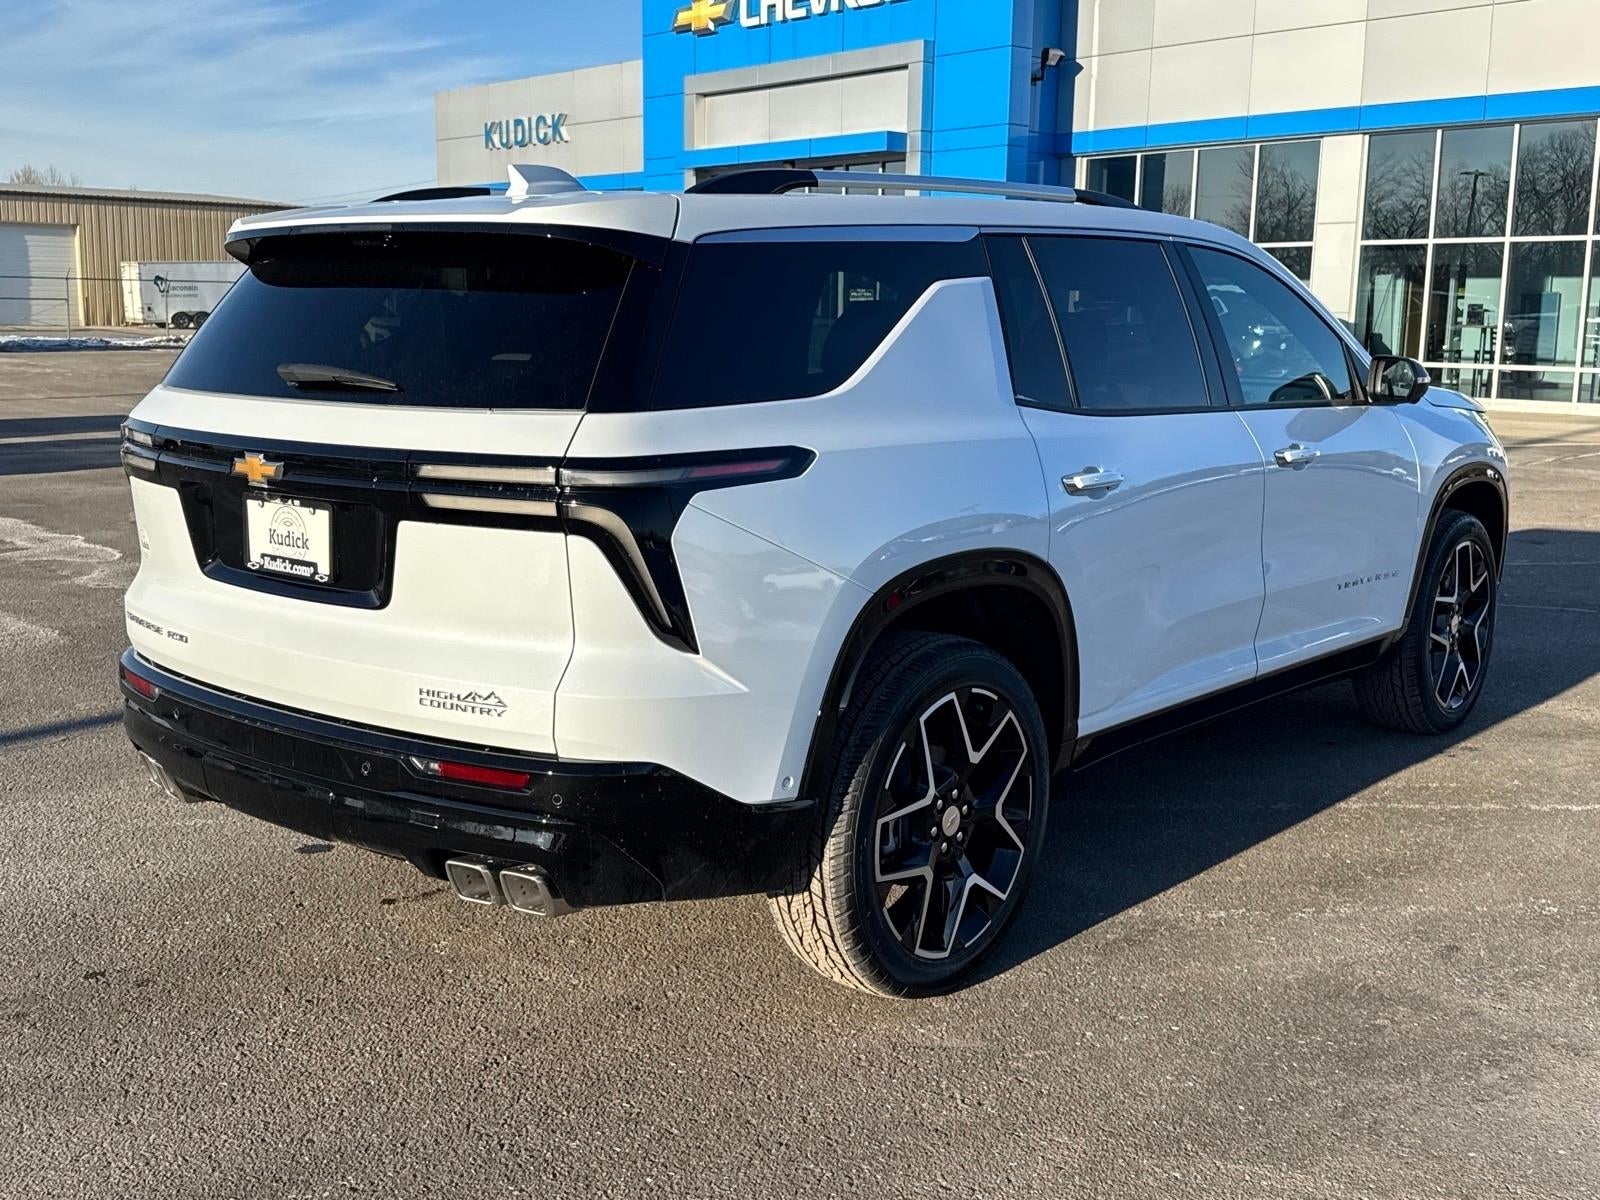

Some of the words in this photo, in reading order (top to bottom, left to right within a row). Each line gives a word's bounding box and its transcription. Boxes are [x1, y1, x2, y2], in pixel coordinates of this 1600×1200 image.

[484, 113, 568, 150] KUDICK
[269, 528, 309, 550] Kudick
[263, 556, 312, 577] Kudick.com
[419, 687, 461, 701] HIGH
[419, 698, 507, 717] COUNTRY
